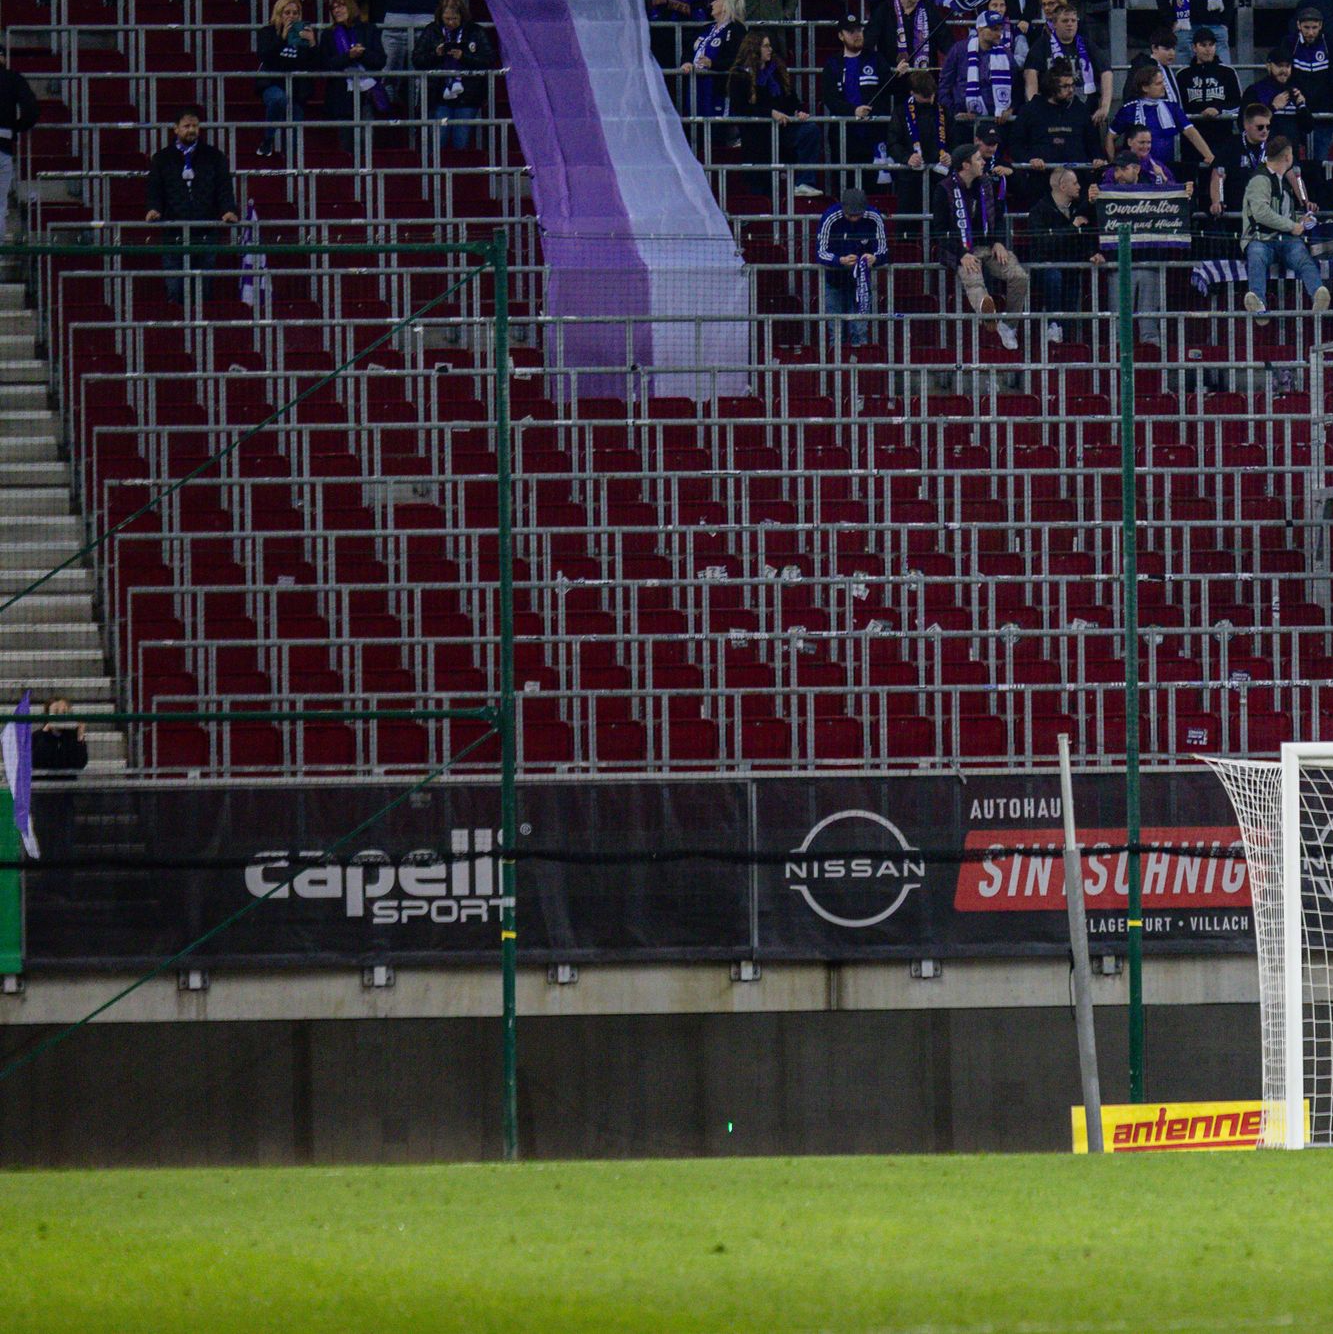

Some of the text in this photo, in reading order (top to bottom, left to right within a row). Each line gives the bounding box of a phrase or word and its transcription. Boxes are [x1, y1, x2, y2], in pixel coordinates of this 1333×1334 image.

[970, 797, 1063, 819] AUTOHAU
[785, 858, 926, 879] NISSAN
[1190, 916, 1249, 932] VILLACH
[1113, 1107, 1267, 1144] antenne
